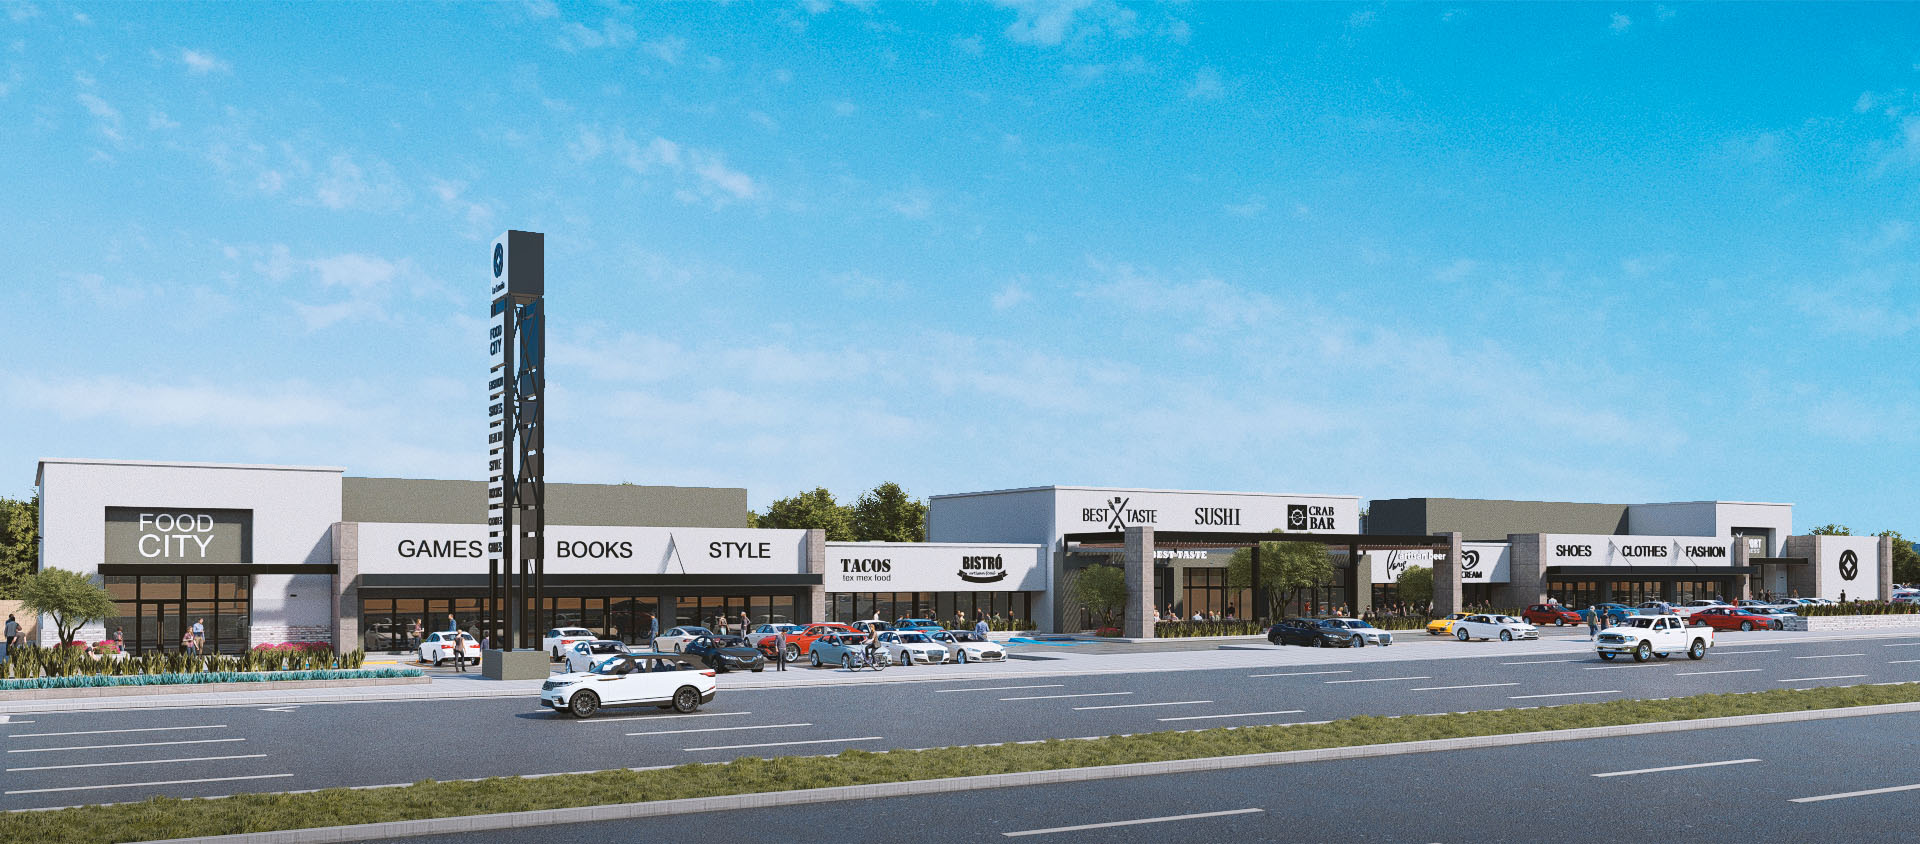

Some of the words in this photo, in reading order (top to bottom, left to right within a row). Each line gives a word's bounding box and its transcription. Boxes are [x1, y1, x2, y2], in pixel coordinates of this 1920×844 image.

[490, 324, 503, 340] FOOD
[490, 338, 502, 356] CITY
[1082, 507, 1110, 522] BEST
[1126, 509, 1158, 523] TASTE
[1194, 507, 1242, 526] SUSHI
[1308, 506, 1335, 516] CRAB
[139, 513, 214, 532] FOOD
[1309, 516, 1336, 530] BAR
[138, 533, 215, 558] CITY
[397, 540, 483, 558] GAMES
[556, 541, 633, 558] BOOKS
[708, 541, 771, 558] STYLE
[1555, 544, 1593, 557] SHOES
[1622, 545, 1668, 557] CLOTHES
[1685, 546, 1726, 558] FASHION
[962, 553, 1003, 570] BISTRÓ
[1176, 550, 1208, 559] TASTE
[1398, 551, 1427, 560] artisan
[1428, 551, 1447, 561] beer
[840, 558, 891, 573] TACOS
[874, 573, 891, 582] food
